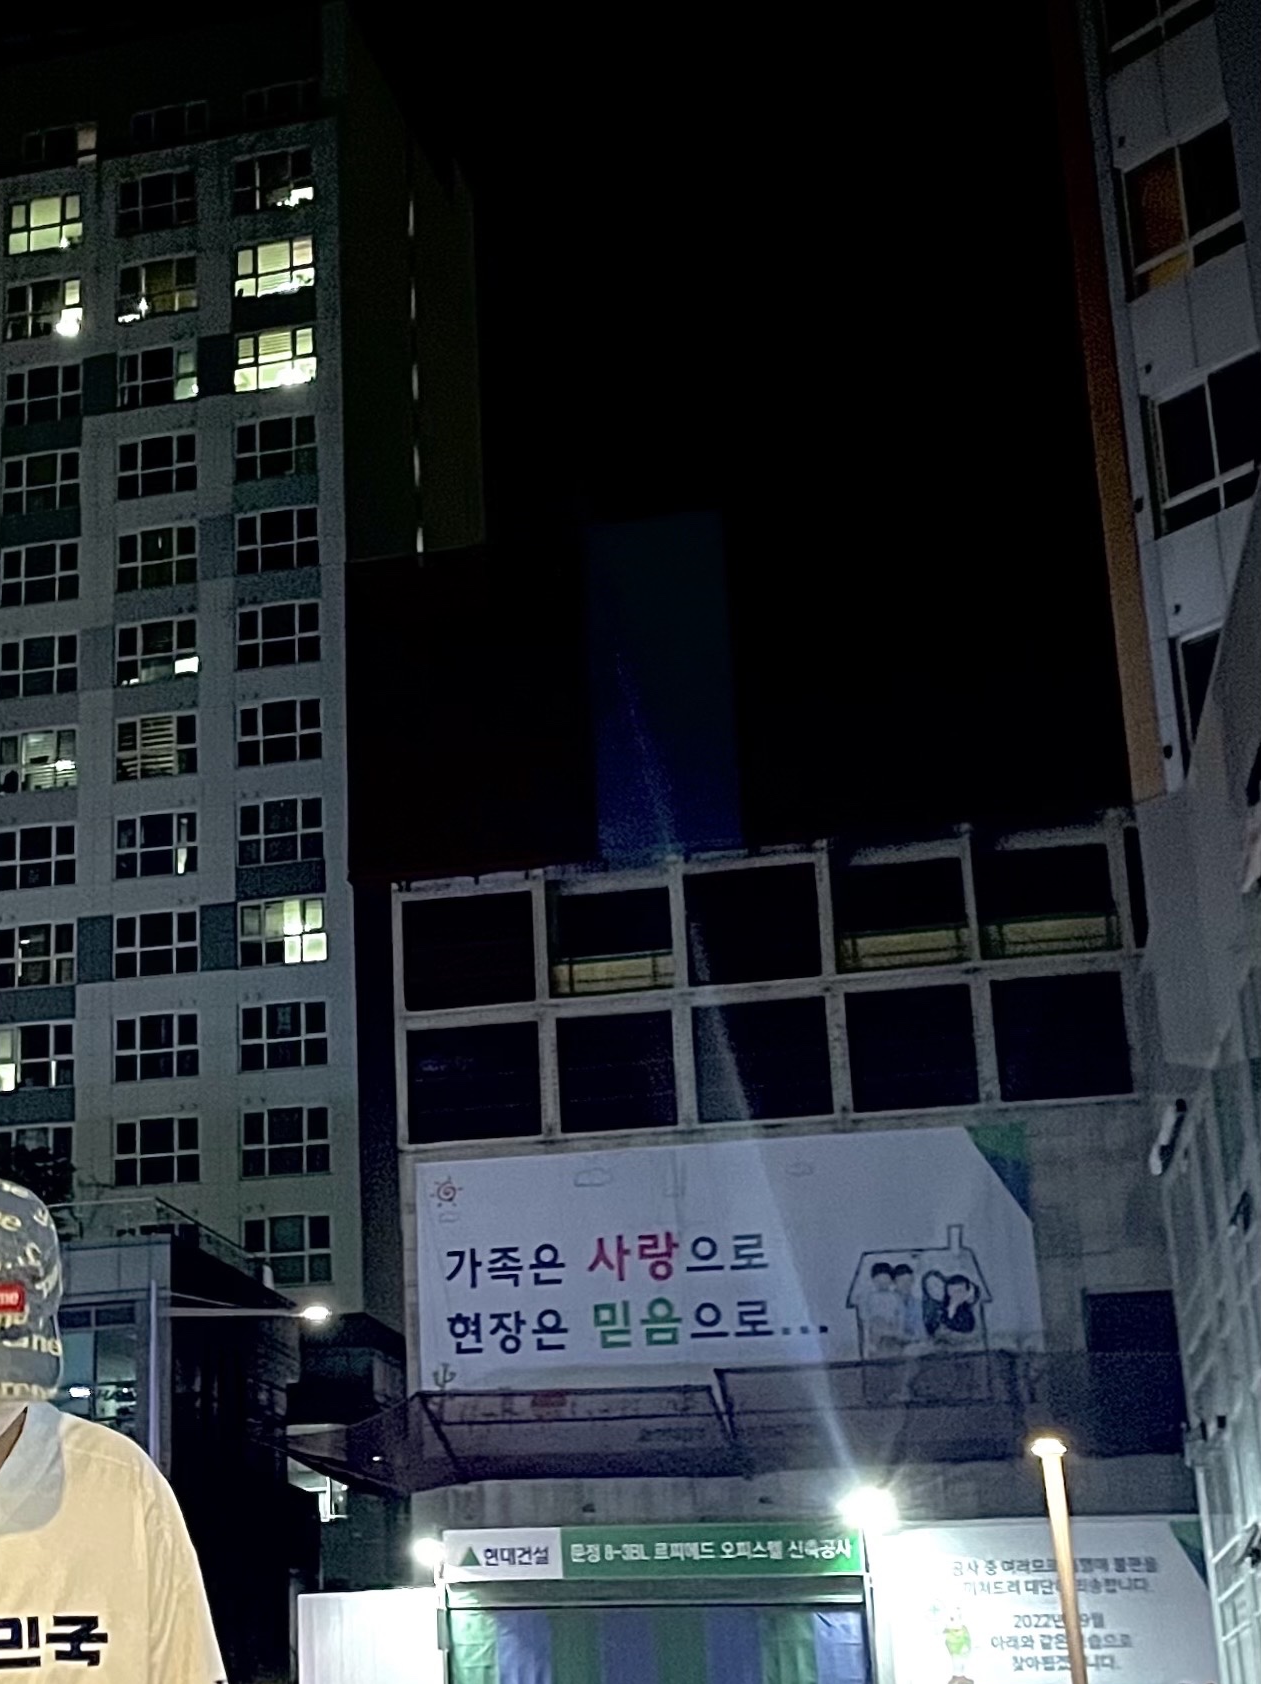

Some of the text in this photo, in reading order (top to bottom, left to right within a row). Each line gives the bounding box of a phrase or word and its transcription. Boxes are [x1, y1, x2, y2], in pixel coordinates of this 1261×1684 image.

[446, 1231, 771, 1288] 가족은 사랑으로
[447, 1308, 569, 1354] 현장은
[484, 1545, 550, 1567] 현대건설
[570, 1543, 601, 1564] 문정
[720, 1539, 783, 1559] 오피스텔
[788, 1536, 854, 1559] 신축공사
[990, 1634, 1035, 1650] 아래와
[1082, 1633, 1133, 1648] 습으로
[1012, 1654, 1122, 1672] 찾아뵙겠니다.
